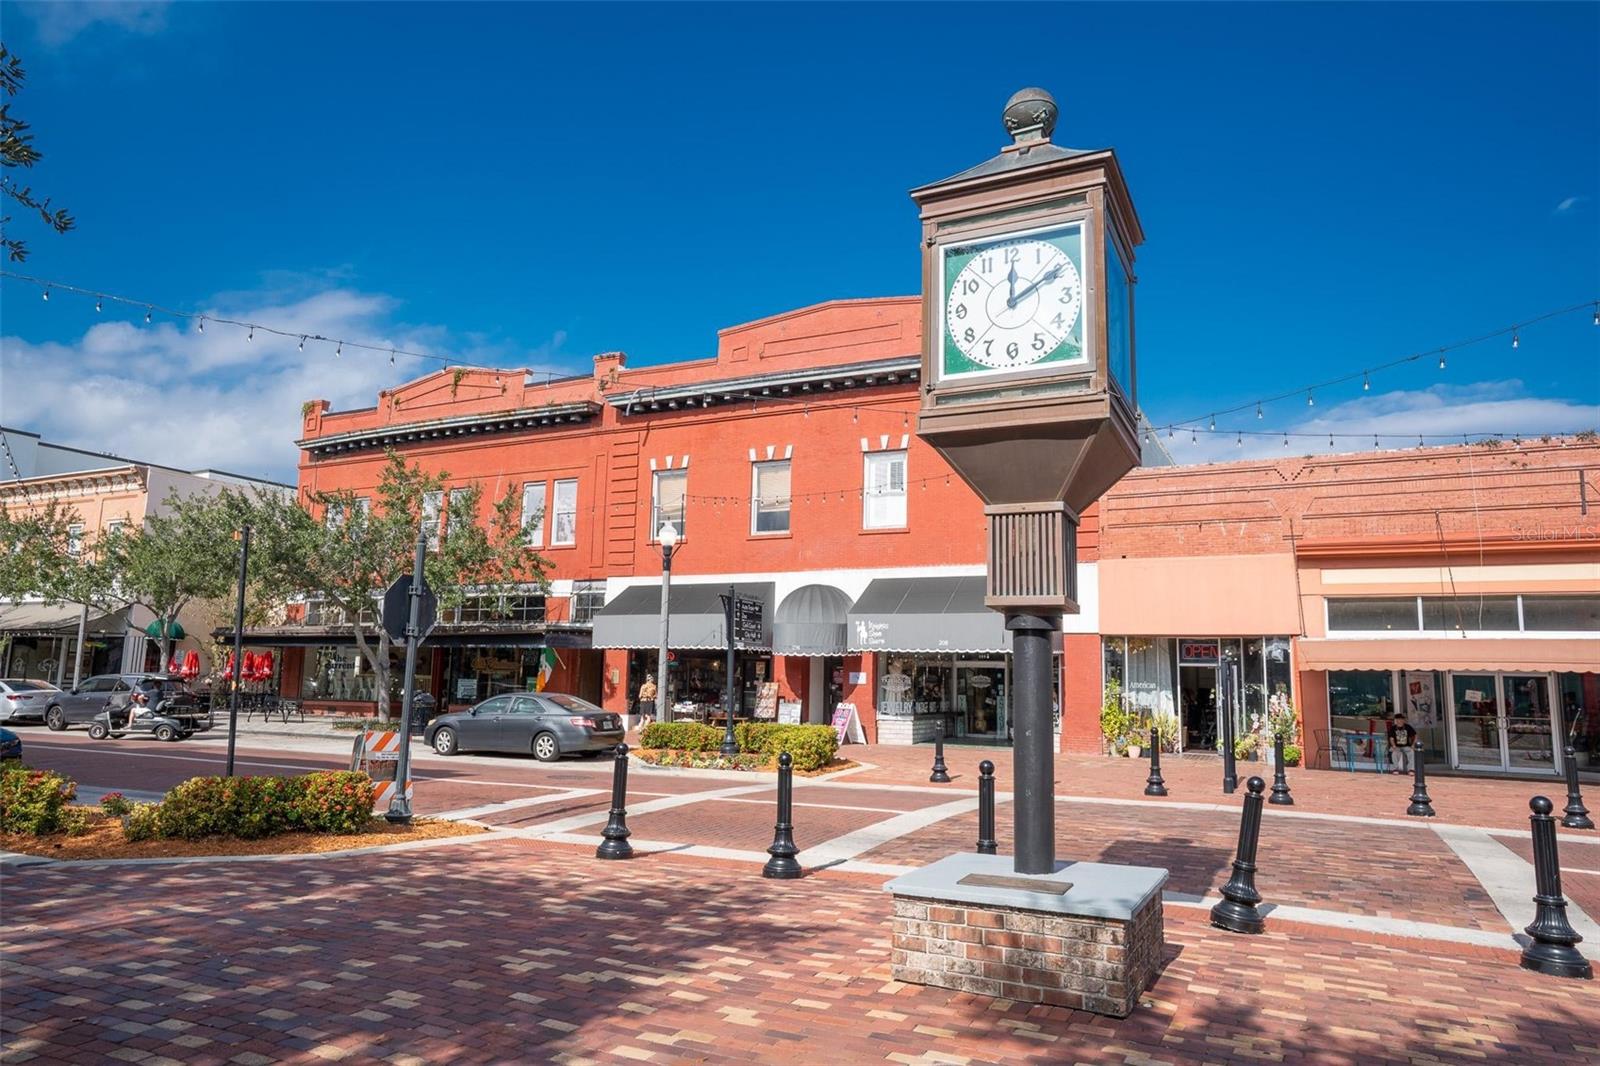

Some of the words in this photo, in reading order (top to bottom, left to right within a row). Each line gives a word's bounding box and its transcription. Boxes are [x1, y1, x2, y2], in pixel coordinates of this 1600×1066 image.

[1004, 248, 1020, 264] 12
[1036, 248, 1041, 265] 1
[981, 257, 993, 274] 11
[962, 278, 979, 295] 10
[1058, 286, 1073, 304] 3
[956, 303, 967, 320] 9
[1050, 312, 1065, 329] 4
[964, 327, 976, 344] 8
[1031, 332, 1046, 351] 5
[983, 339, 995, 358] 7
[1006, 342, 1019, 361] 6
[335, 654, 347, 662] the
[1184, 645, 1219, 657] OPEN
